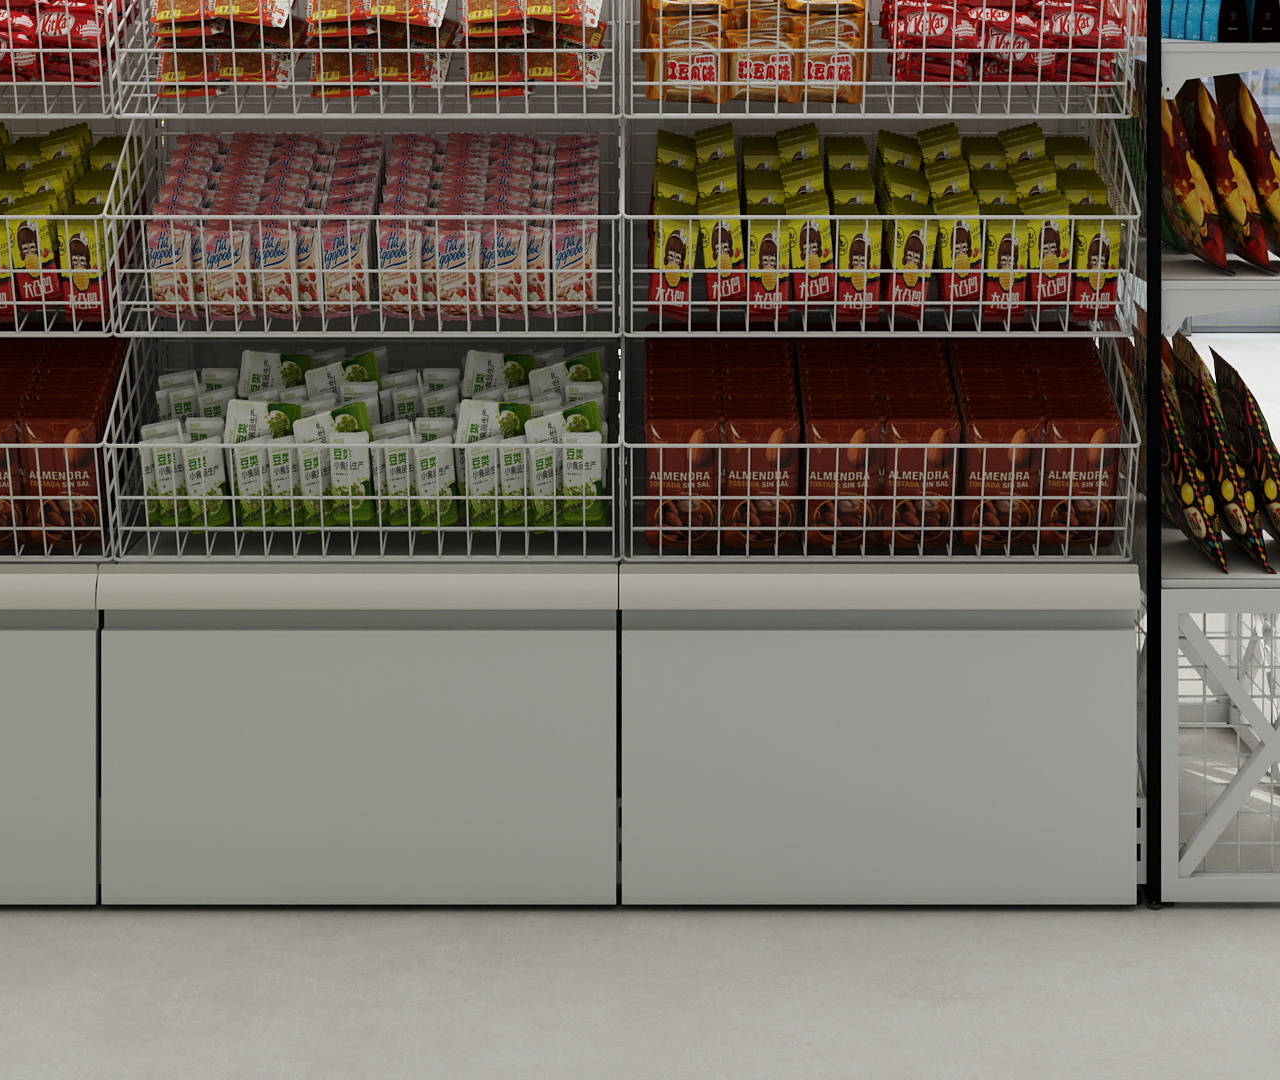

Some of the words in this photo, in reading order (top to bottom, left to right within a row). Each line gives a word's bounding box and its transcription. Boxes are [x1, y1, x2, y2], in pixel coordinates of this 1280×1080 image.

[976, 8, 1006, 21] KitKat
[39, 12, 72, 34] KitKat
[912, 14, 945, 36] KitKat
[1057, 14, 1090, 36] KitKat
[156, 233, 169, 249] На
[214, 237, 227, 251] На
[248, 409, 258, 440] 食品生产
[29, 471, 90, 480] ALMENDRA
[650, 471, 710, 481] ALMENDRA
[729, 470, 789, 480] ALMENDRA
[888, 470, 949, 480] ALMENDRA
[969, 471, 1030, 481] ALMENDRA
[1048, 470, 1109, 480] ALMENDRA
[30, 480, 60, 488] TOSTADA
[650, 481, 680, 489] TOSTADA
[888, 480, 919, 488] TOSTADA
[1048, 480, 1079, 488] TOSTADA
